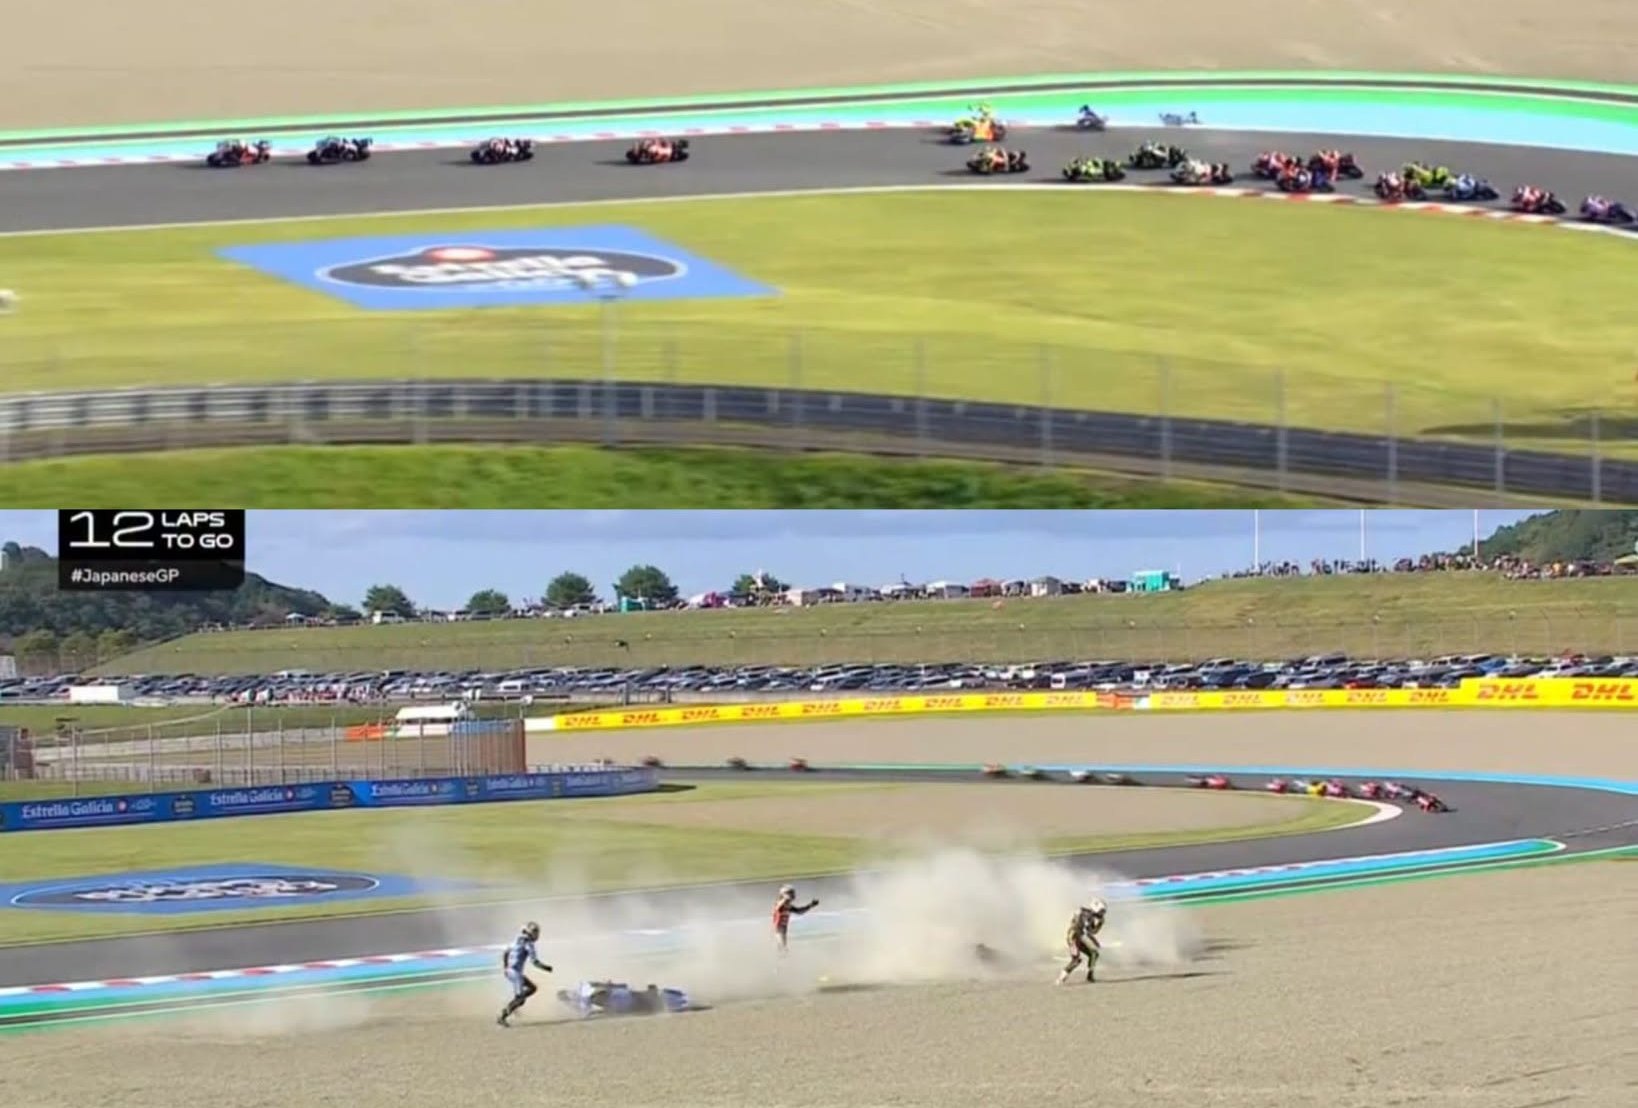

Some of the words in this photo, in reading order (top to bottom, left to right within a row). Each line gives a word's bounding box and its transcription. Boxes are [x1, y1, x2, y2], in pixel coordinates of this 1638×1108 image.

[1477, 683, 1539, 699] DHL
[1572, 683, 1635, 699] DHL
[925, 697, 964, 708] DHL
[985, 694, 1024, 705] DHL
[1223, 693, 1262, 704] DHL
[1347, 691, 1388, 703] DHL
[1409, 691, 1450, 703] DHL
[802, 703, 842, 714] DHL
[863, 700, 903, 711] DHL
[682, 709, 720, 720] DHL
[741, 706, 780, 717] DHL
[564, 716, 601, 726] DHL
[622, 713, 660, 724] DHL
[210, 792, 249, 805] Estrella
[22, 803, 69, 819] Estrella
[71, 799, 114, 816] Galicia
